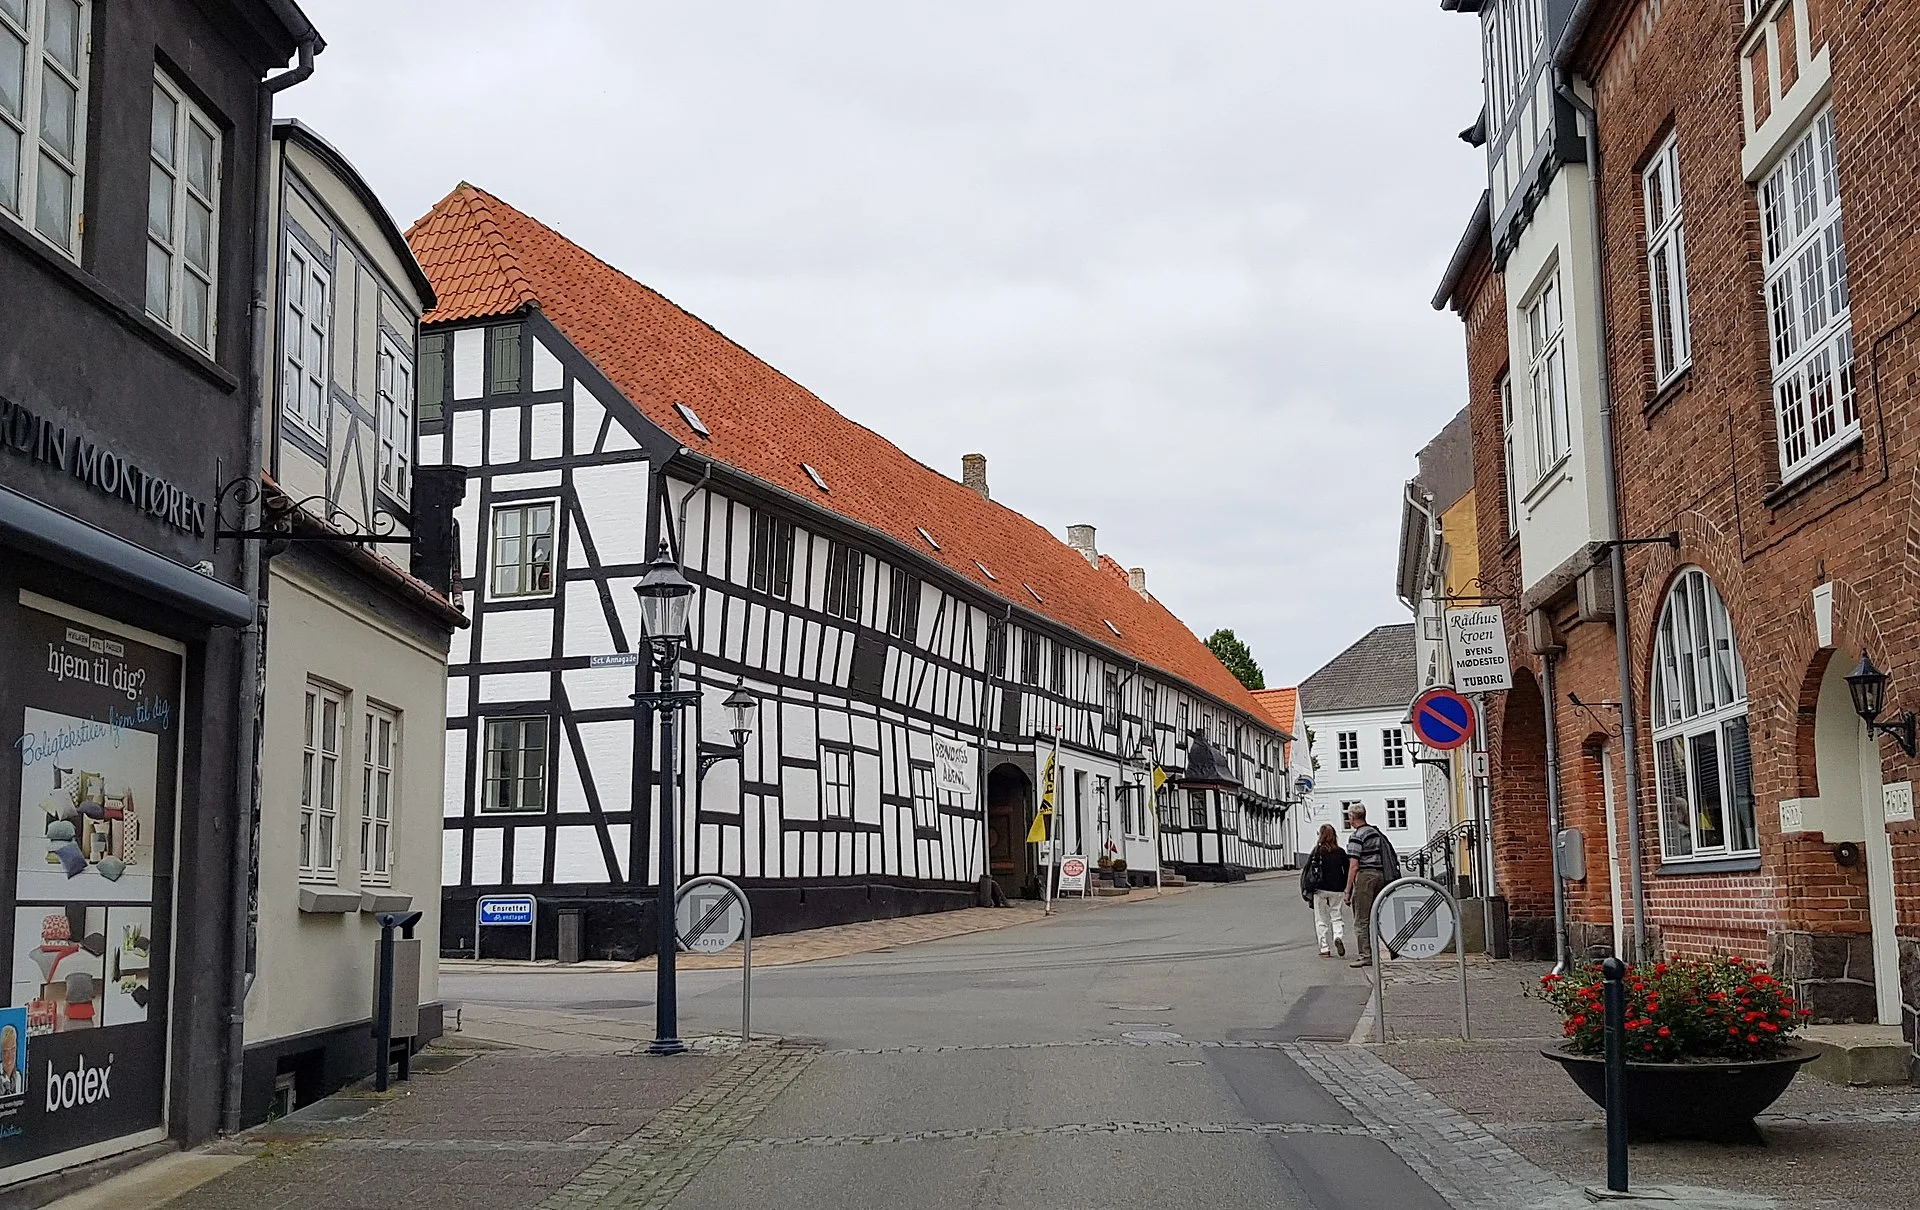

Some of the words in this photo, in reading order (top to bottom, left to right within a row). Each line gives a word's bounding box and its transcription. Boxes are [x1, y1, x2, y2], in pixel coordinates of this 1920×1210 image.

[76, 436, 206, 538] MONTØREN
[1451, 611, 1498, 629] Rådhus
[1460, 628, 1493, 645] kroen
[1465, 646, 1493, 657] BYENS
[1456, 656, 1505, 668] MØDESTED
[48, 643, 90, 682] hjem
[93, 657, 109, 687] til
[112, 663, 146, 700] dig?
[1462, 674, 1504, 687] TUBORG
[492, 904, 527, 912] Ensrettet
[46, 1053, 113, 1113] botex
